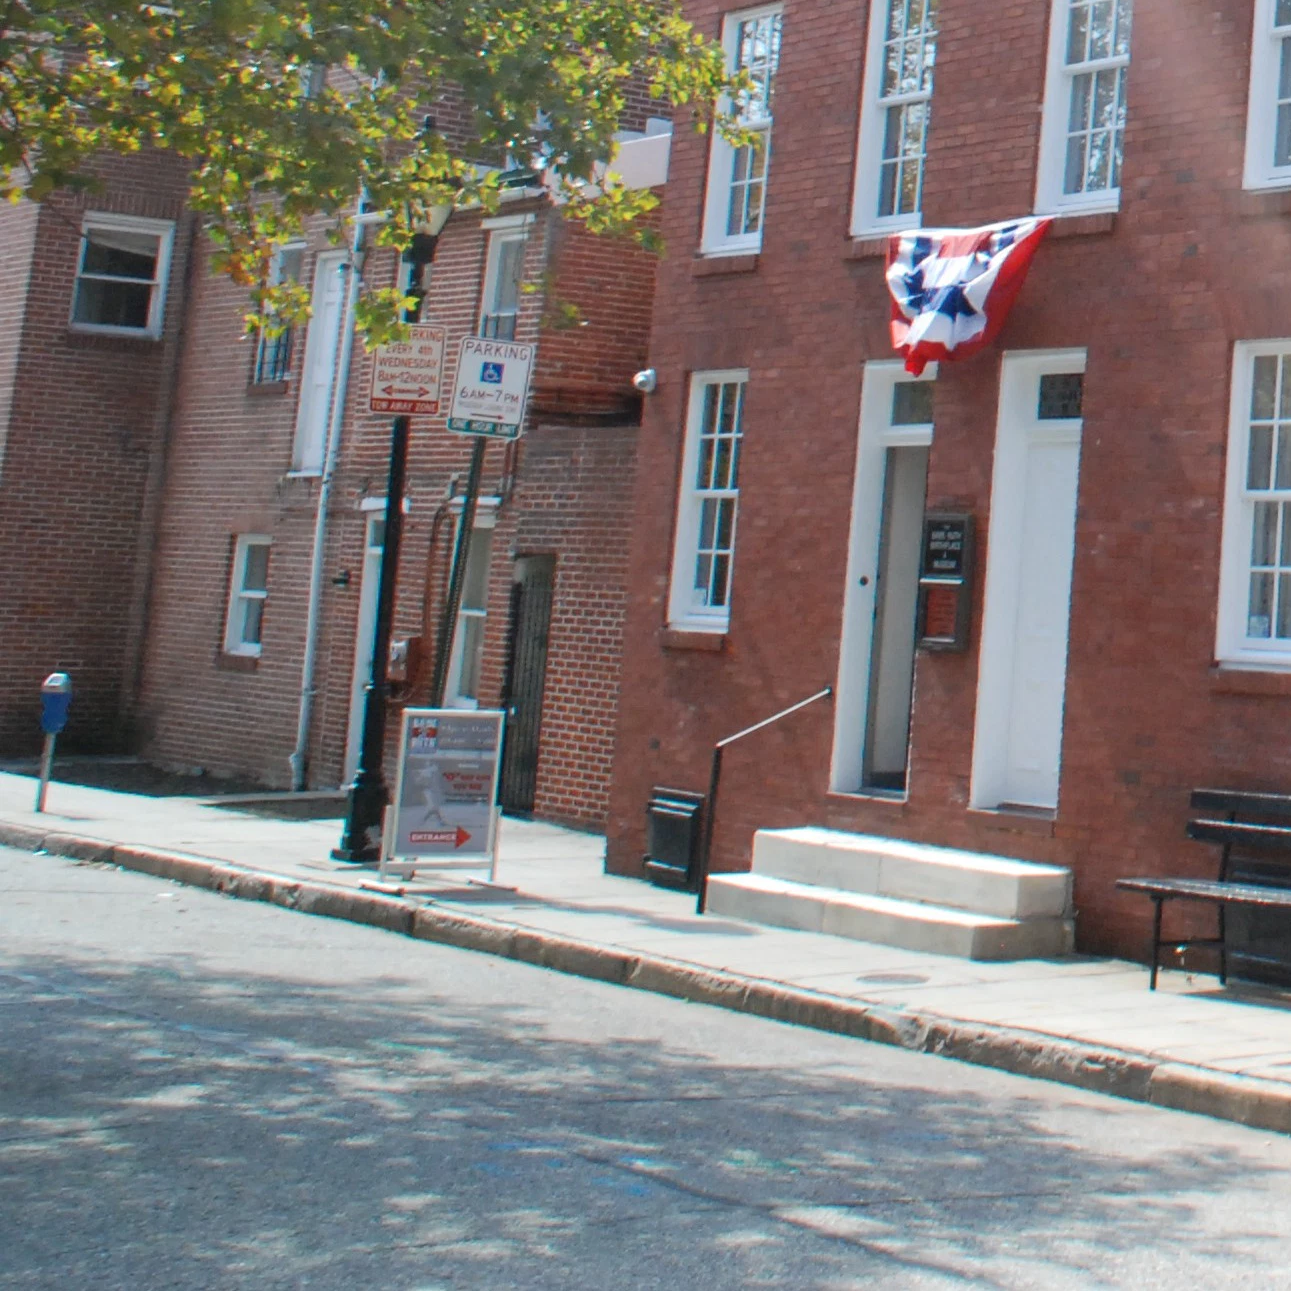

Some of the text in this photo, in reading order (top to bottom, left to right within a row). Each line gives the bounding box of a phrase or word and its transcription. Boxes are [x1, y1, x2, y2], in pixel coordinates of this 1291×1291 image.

[465, 341, 528, 362] PARKING
[378, 357, 439, 369] WEDNESDAY
[411, 833, 457, 842] ENTRANCE
